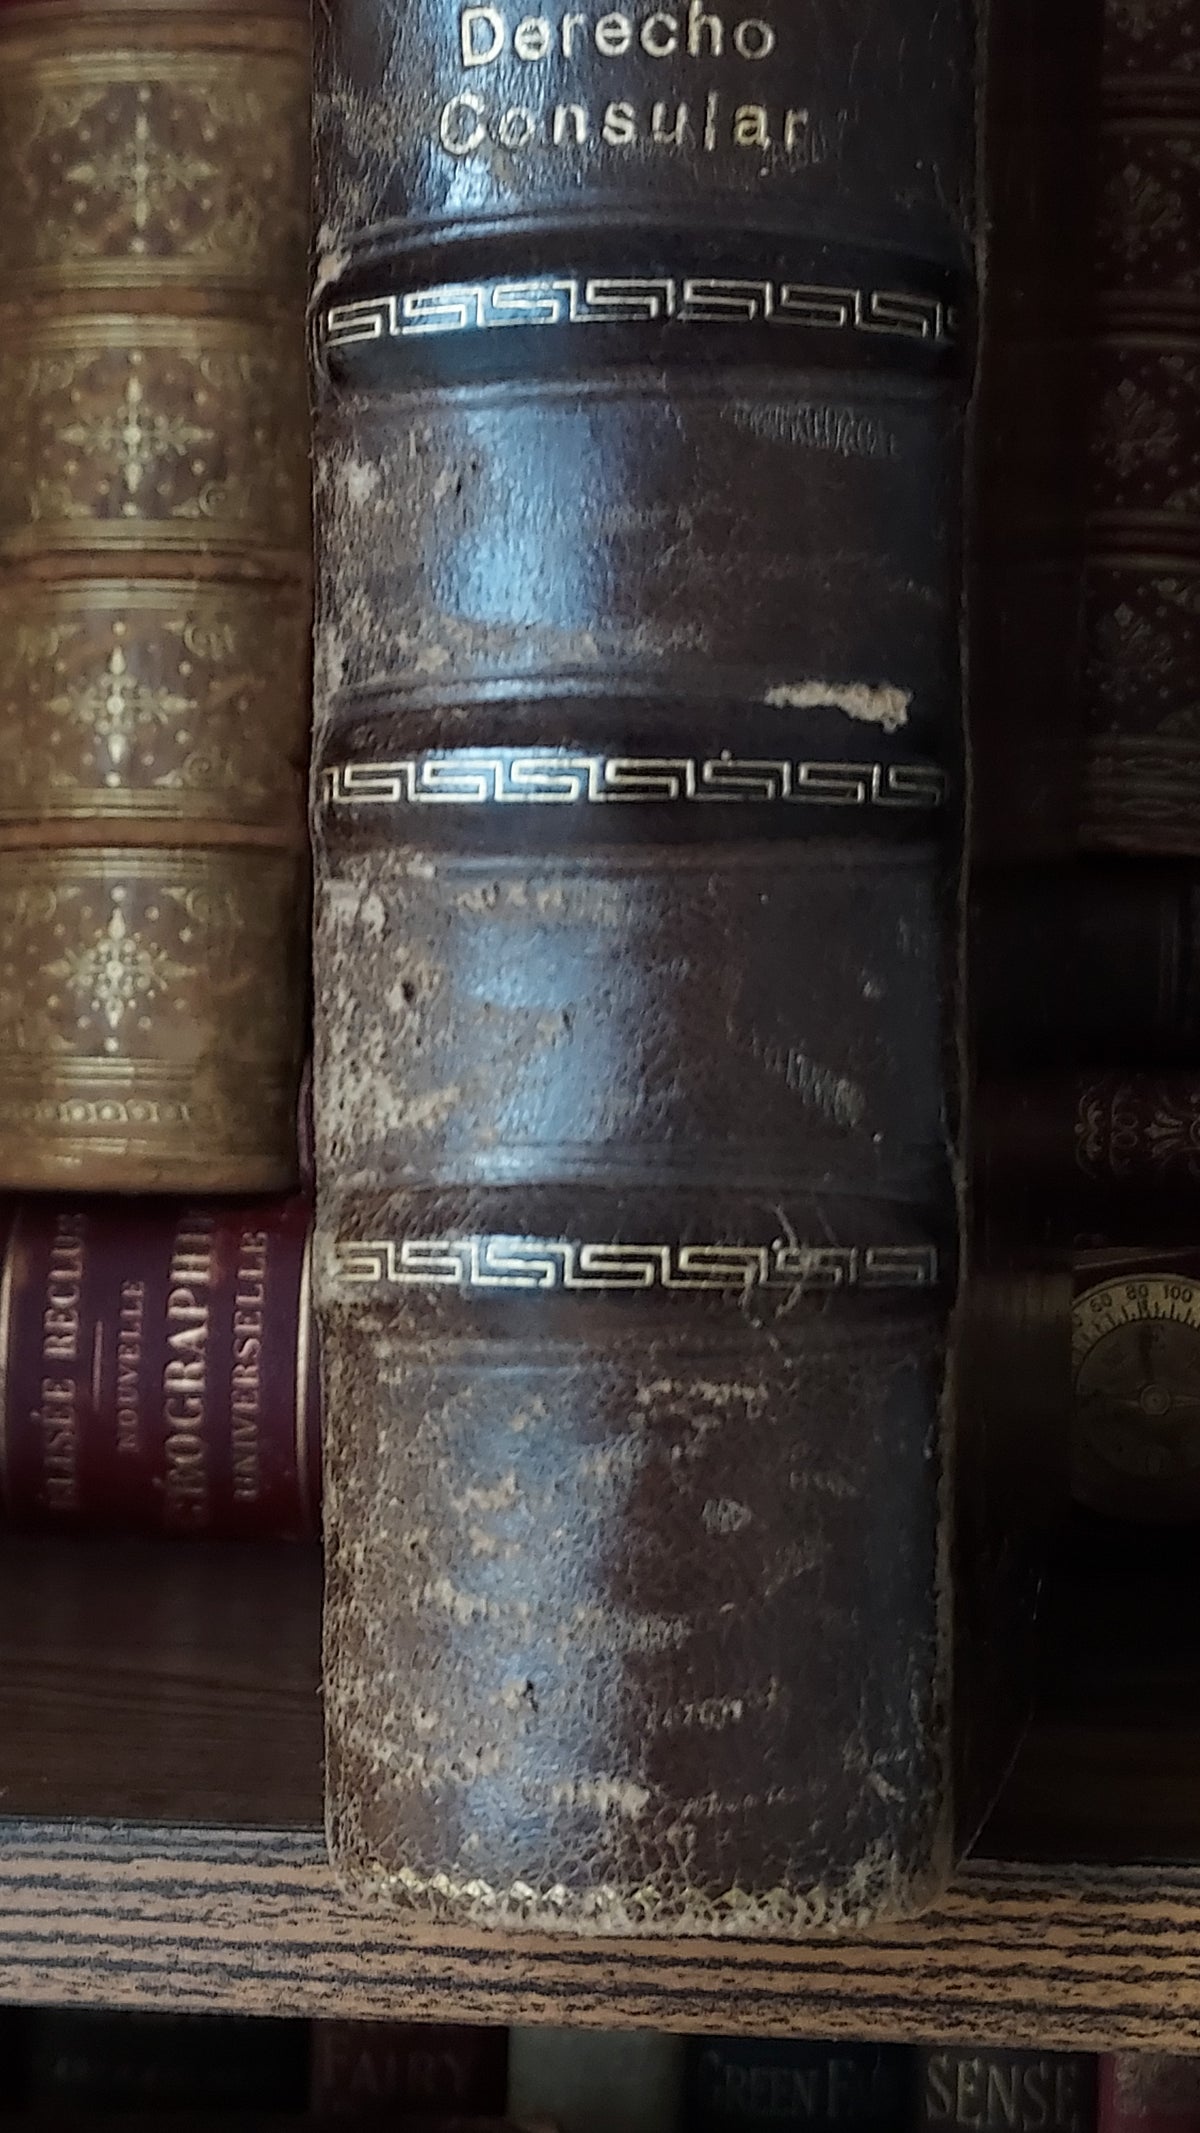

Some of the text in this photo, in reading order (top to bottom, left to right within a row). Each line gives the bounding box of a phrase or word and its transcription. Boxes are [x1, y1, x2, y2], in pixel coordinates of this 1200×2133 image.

[461, 0, 775, 67] Derecho
[440, 90, 809, 155] Consular
[43, 1214, 86, 1361] RECLUS
[1125, 1284, 1149, 1301] 80
[1164, 1284, 1193, 1303] 100
[116, 1280, 145, 1451] NOUVELLE
[231, 1231, 269, 1500] UNIVERSELLE
[925, 2054, 1080, 2133] SENSE
